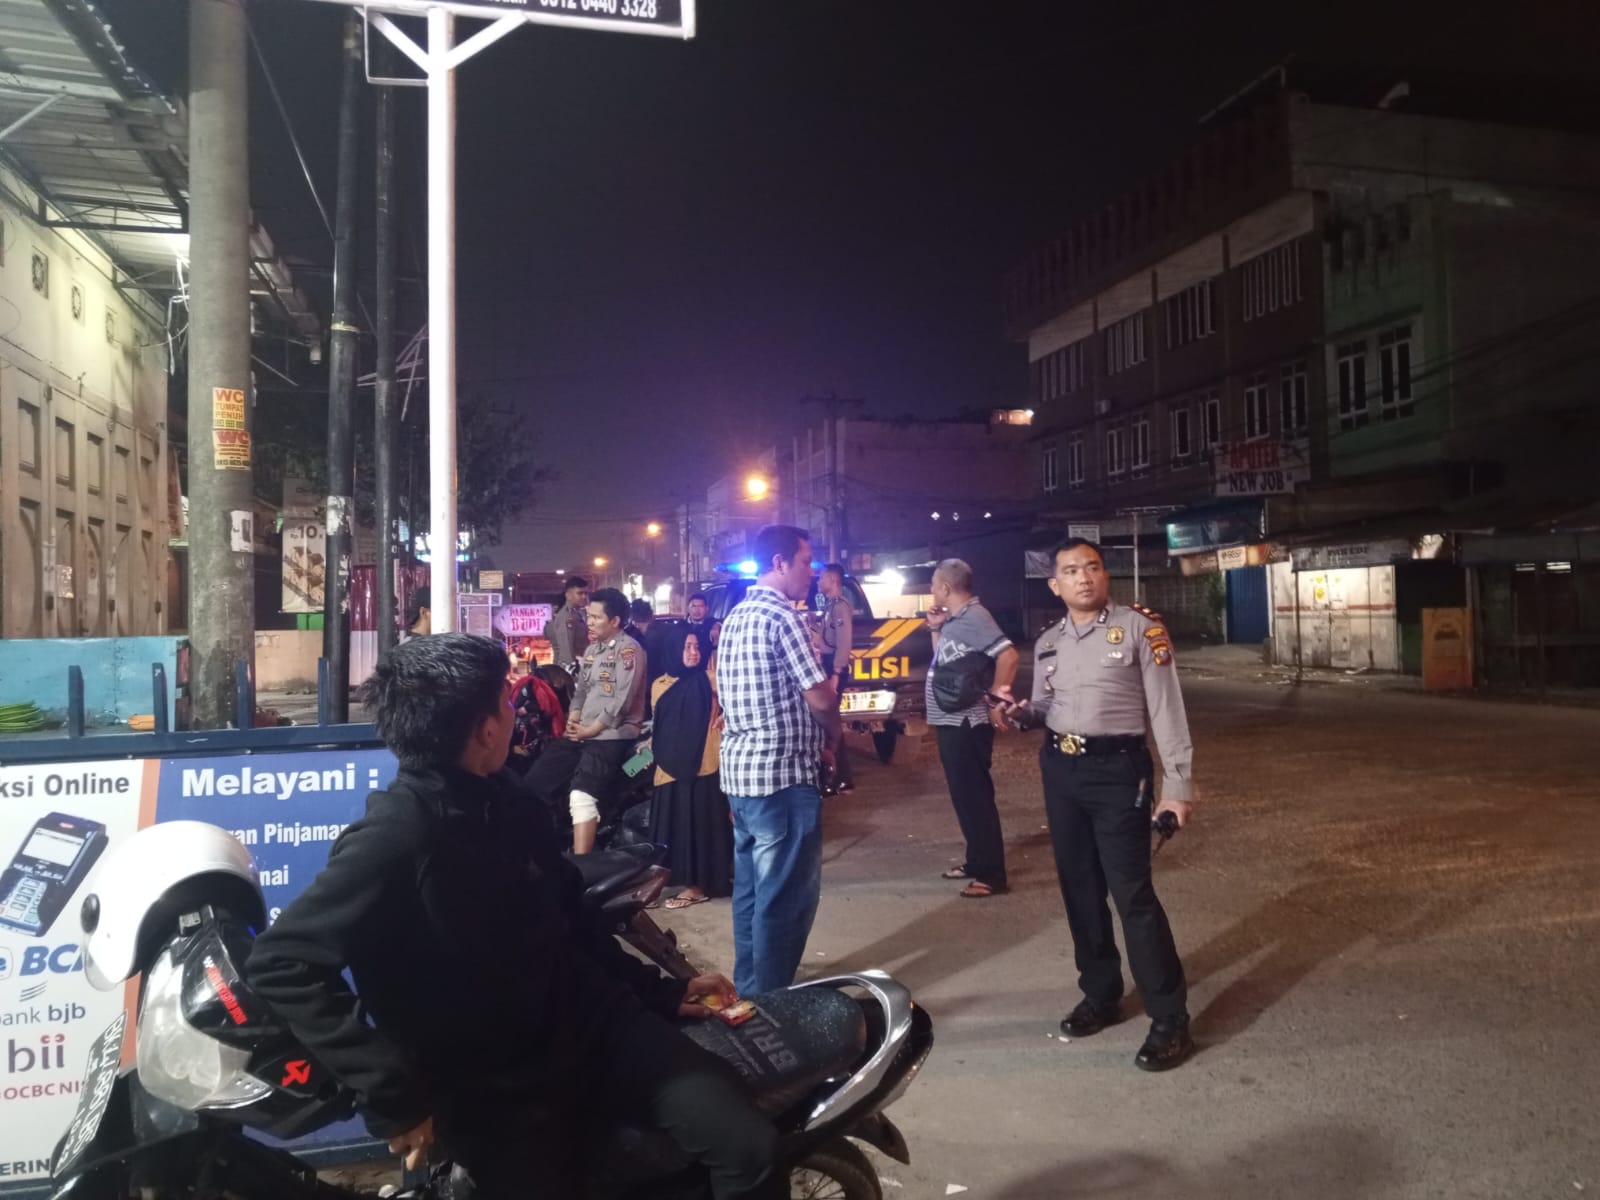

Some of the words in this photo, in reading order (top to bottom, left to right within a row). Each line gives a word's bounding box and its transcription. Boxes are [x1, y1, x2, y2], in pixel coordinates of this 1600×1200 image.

[621, 0, 657, 19] 3328
[216, 389, 243, 403] WC
[217, 431, 249, 445] WC
[44, 772, 130, 796] Online
[182, 763, 355, 800] Melayani
[48, 1002, 86, 1024] bjb
[8, 1033, 65, 1074] bii
